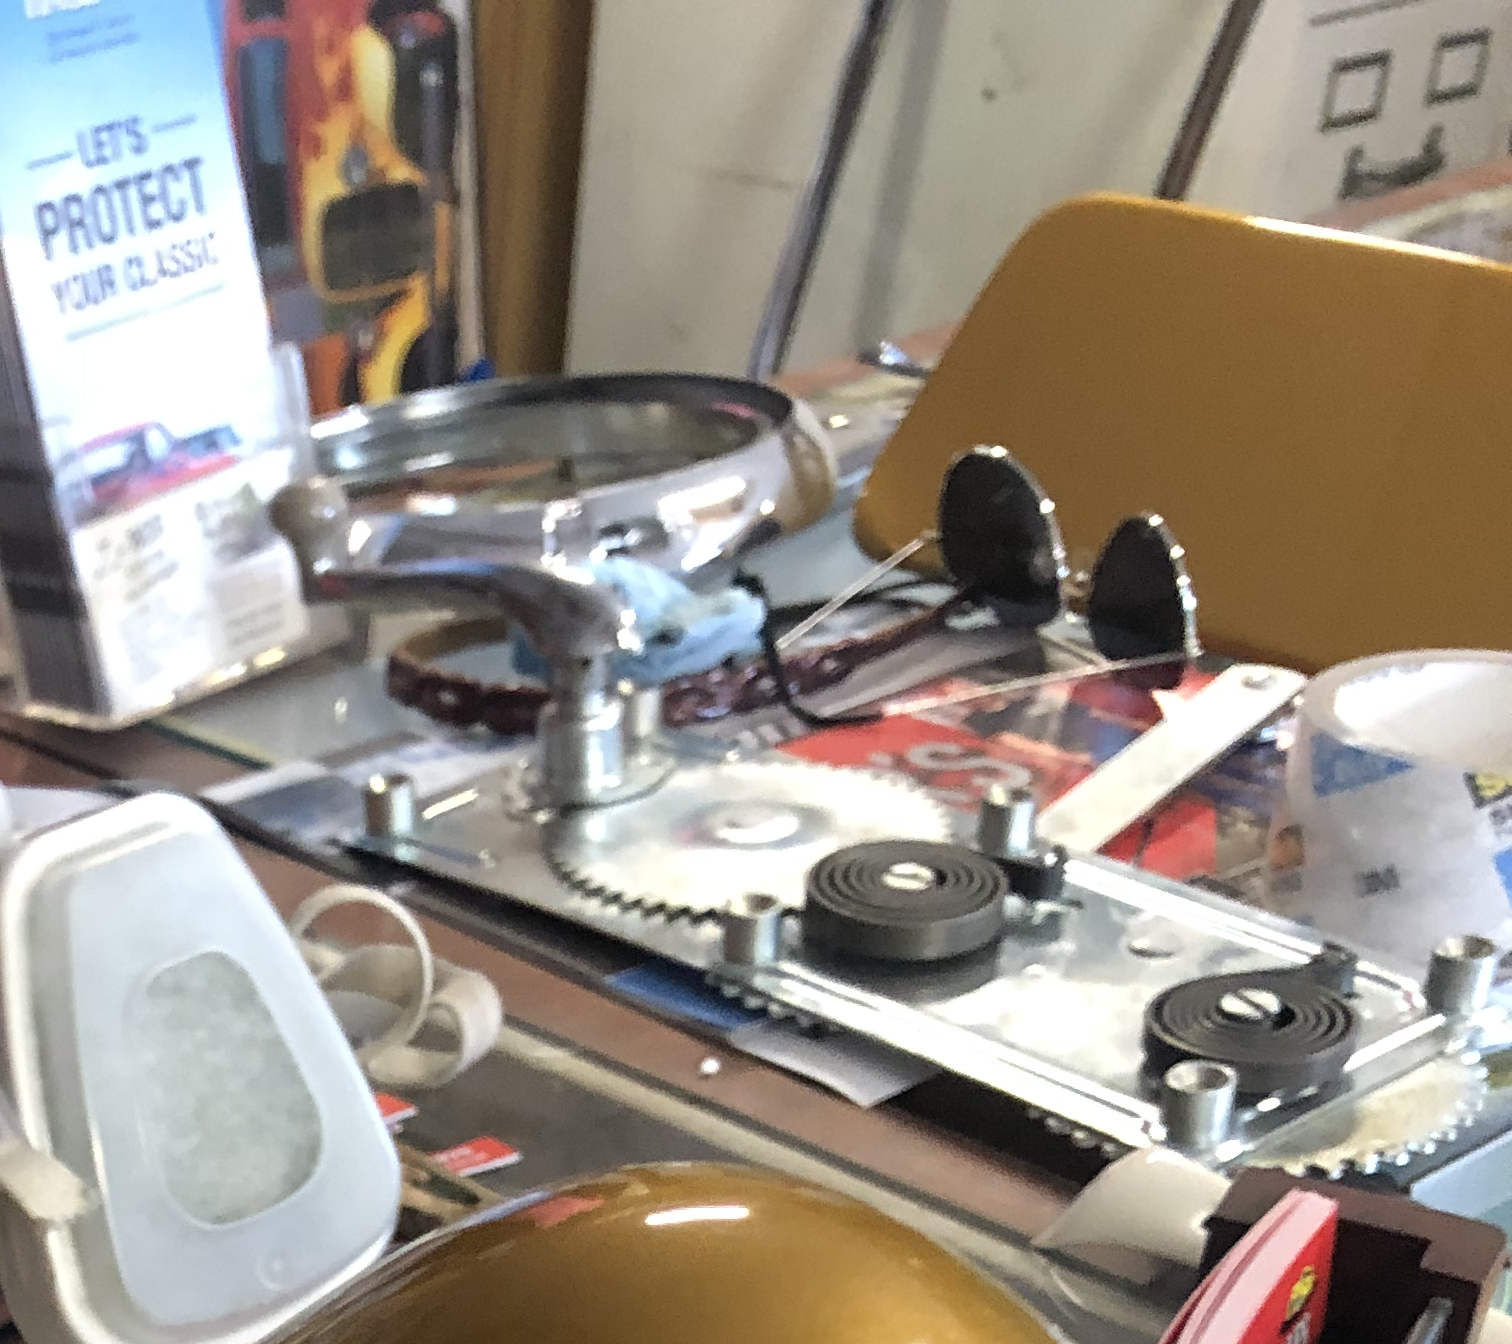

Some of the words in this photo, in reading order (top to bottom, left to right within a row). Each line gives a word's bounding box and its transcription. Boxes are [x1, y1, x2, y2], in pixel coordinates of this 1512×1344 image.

[76, 114, 150, 169] LET'S
[34, 156, 205, 262] PROTECT
[51, 263, 118, 314] YOUR
[123, 231, 219, 291] CLASSIC
